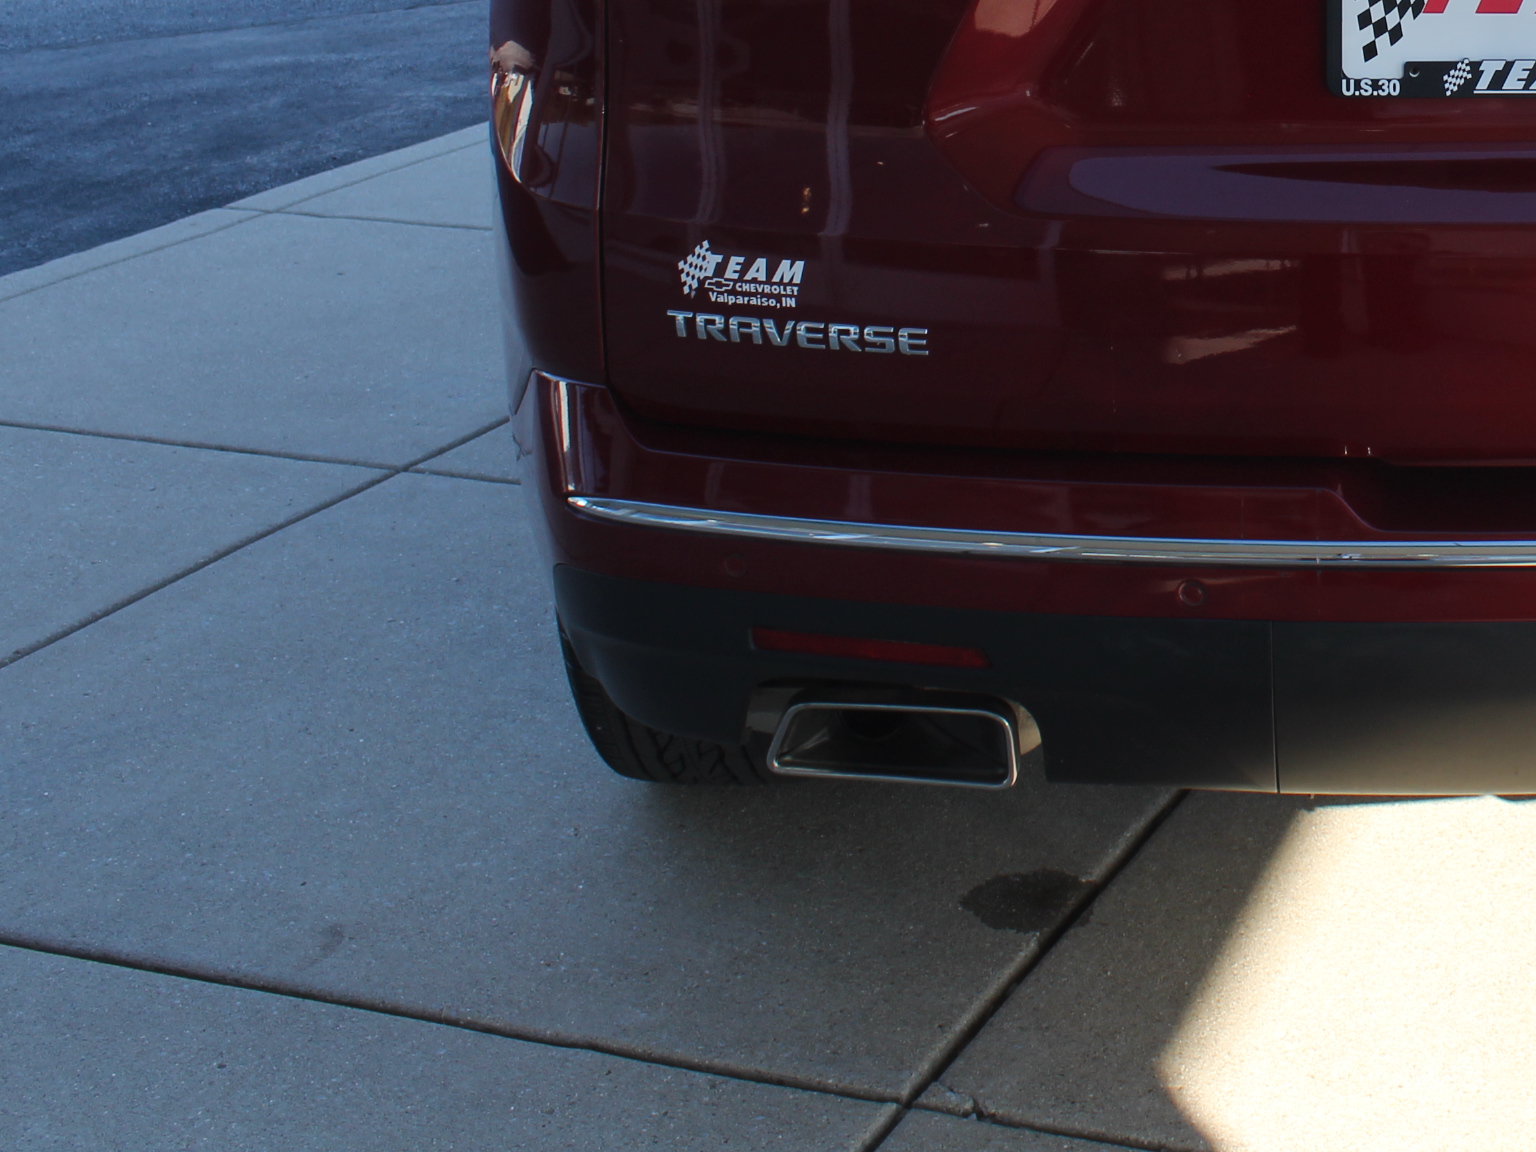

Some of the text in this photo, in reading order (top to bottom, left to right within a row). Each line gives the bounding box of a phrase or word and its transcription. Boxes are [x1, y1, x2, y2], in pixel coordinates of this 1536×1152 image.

[1341, 78, 1401, 97] U.S.30
[701, 254, 805, 284] TEAM
[735, 282, 799, 296] CHEVROLET
[666, 309, 930, 356] TRAVERSE
